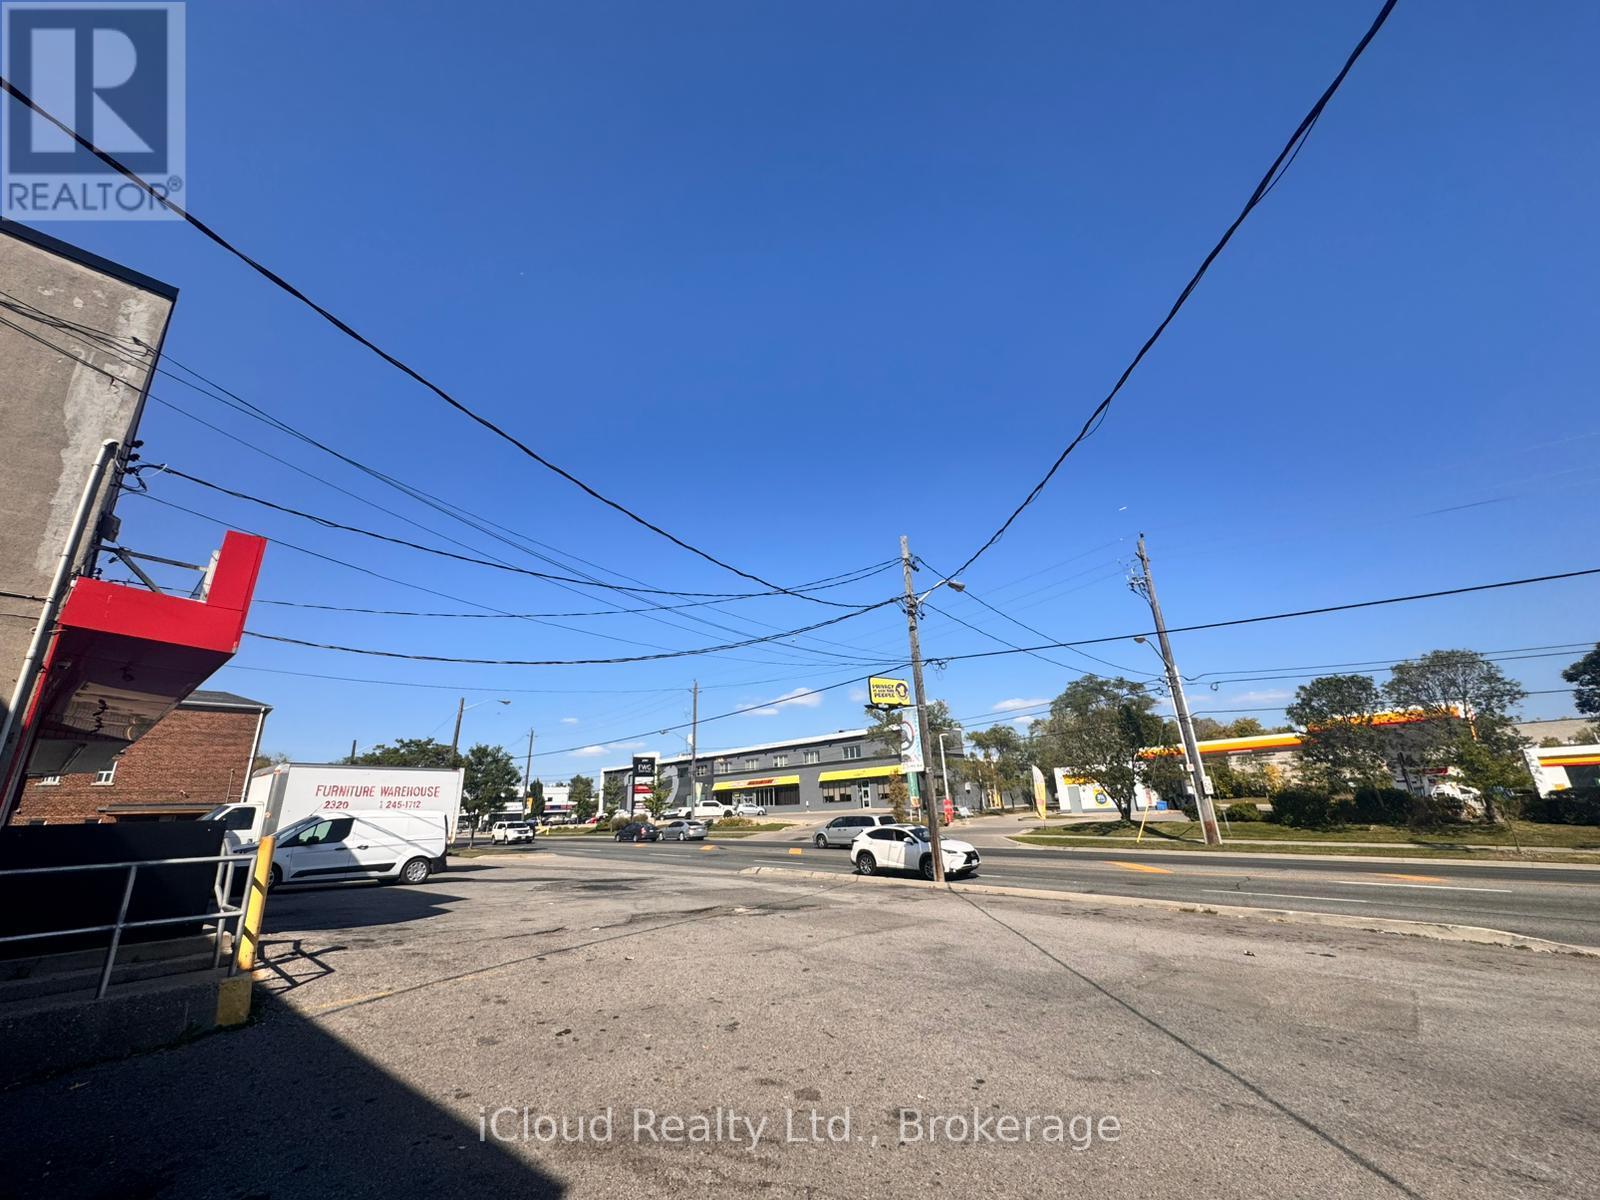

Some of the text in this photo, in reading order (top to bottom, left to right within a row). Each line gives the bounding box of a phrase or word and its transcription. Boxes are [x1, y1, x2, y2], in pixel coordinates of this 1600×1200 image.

[315, 784, 441, 798] FURNITURE WAREHOUSE
[323, 800, 349, 809] 2320
[385, 800, 422, 809] 245-1712
